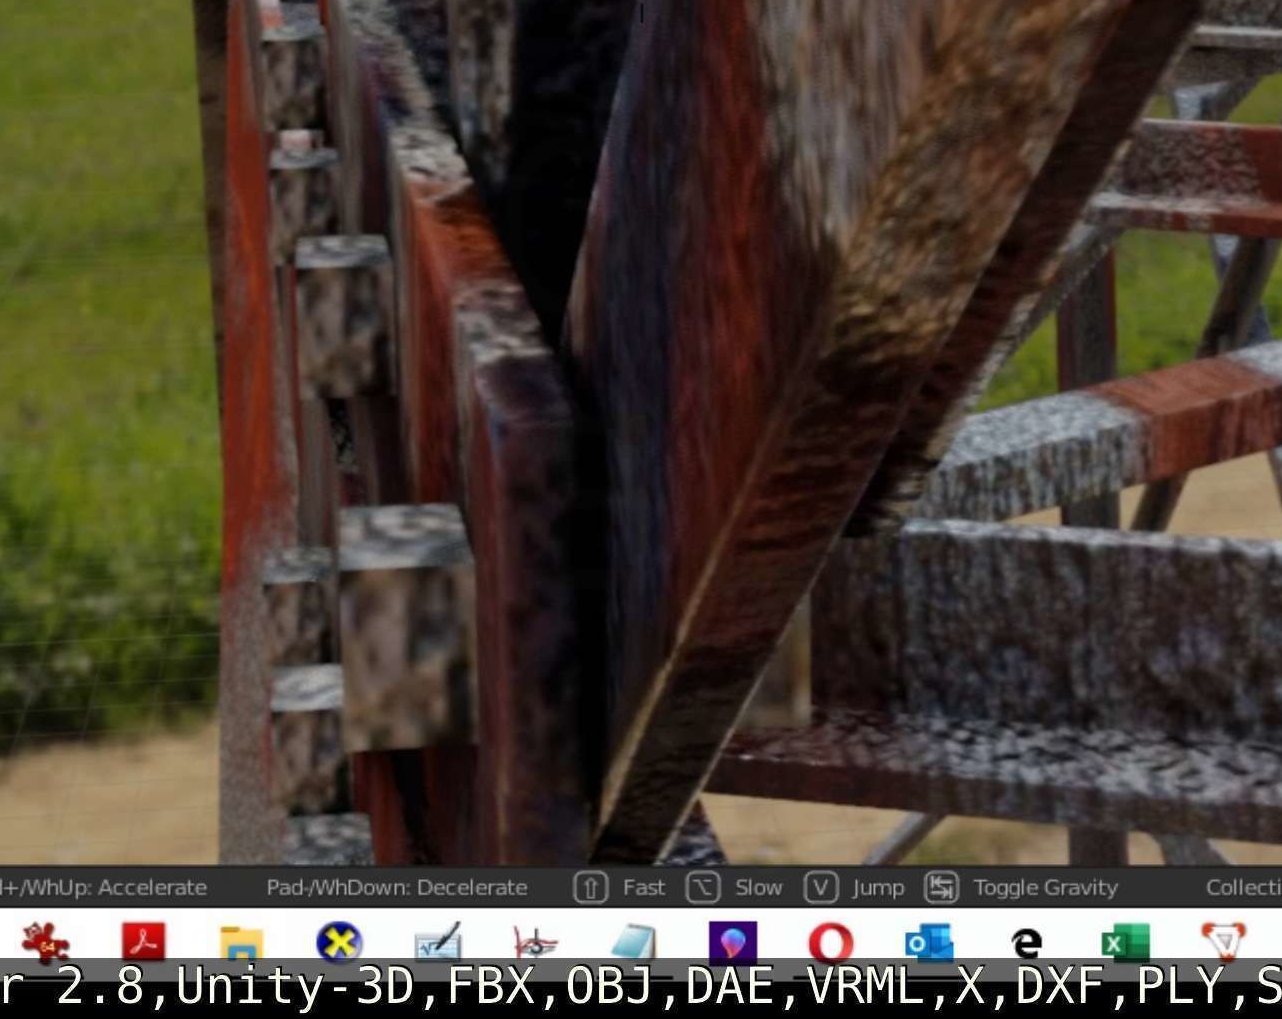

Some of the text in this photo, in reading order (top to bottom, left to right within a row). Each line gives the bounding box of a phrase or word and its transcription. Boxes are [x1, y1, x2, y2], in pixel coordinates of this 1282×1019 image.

[97, 878, 208, 896] Accelerate
[267, 878, 528, 898] Pad-/WhDown: Decelerate
[624, 878, 666, 896] Fast
[736, 878, 783, 896] Slow
[810, 877, 829, 897] V
[851, 878, 905, 900] Jump
[973, 878, 1119, 900] Toggle Gravity
